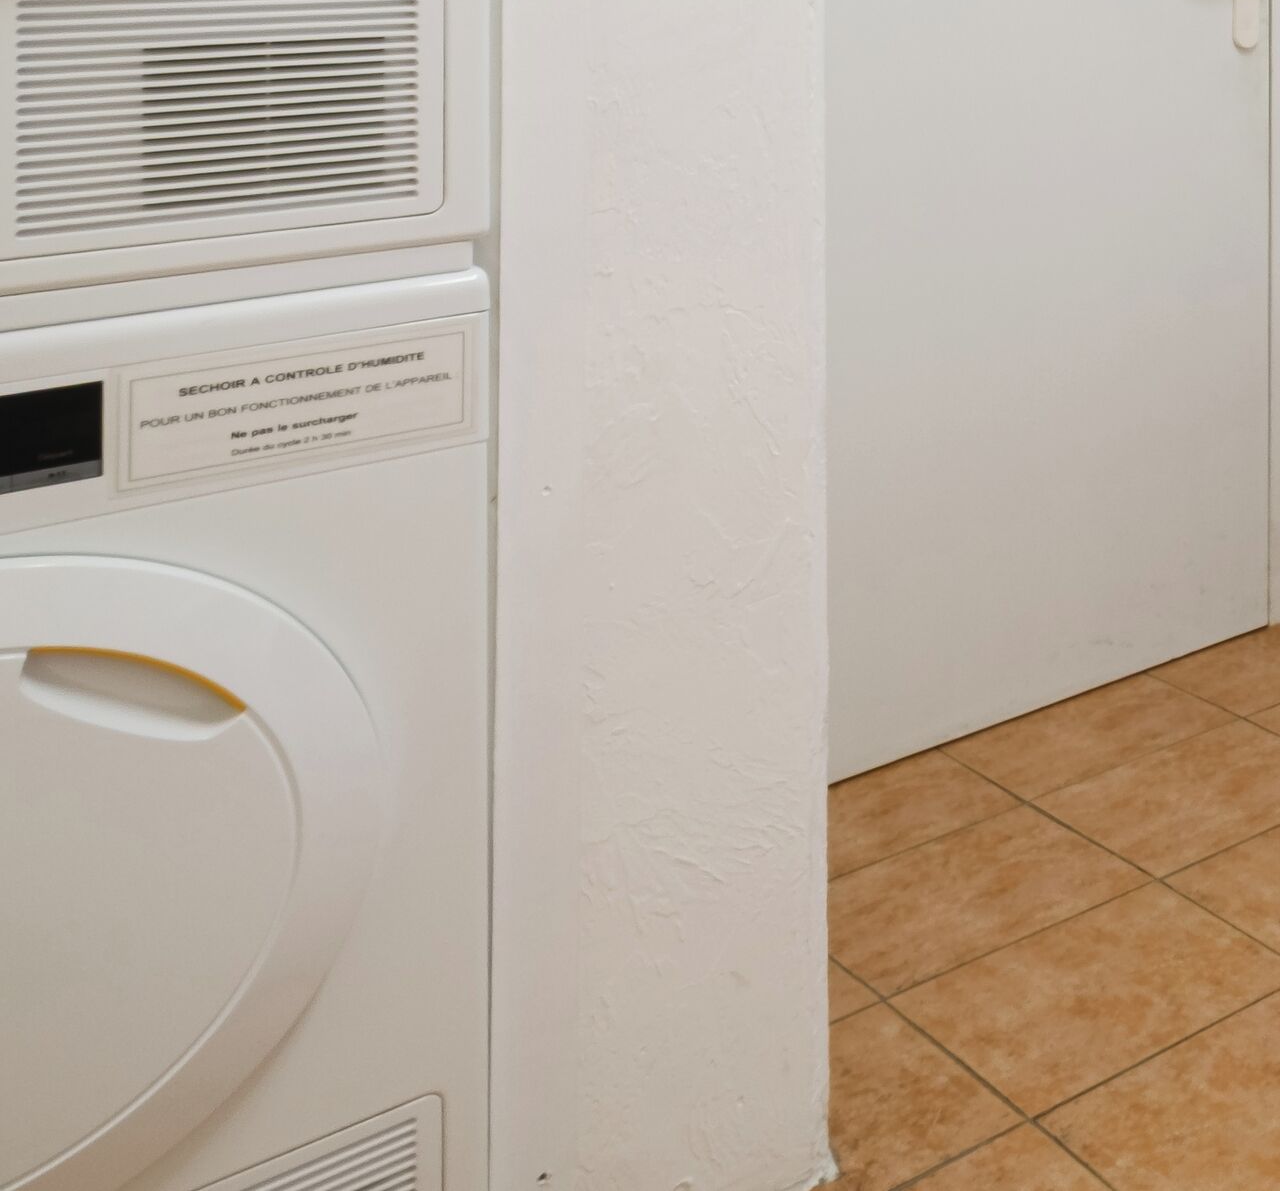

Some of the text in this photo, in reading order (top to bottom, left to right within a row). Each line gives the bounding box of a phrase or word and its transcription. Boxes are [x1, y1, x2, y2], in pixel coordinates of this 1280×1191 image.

[178, 351, 425, 397] SECHOIR A CONTROLE D'HUMIDITE
[139, 372, 452, 429] POUR UN BON FONCTIONNEMENT DE L'APPAREIL
[231, 412, 359, 440] Ne pas le surcharger
